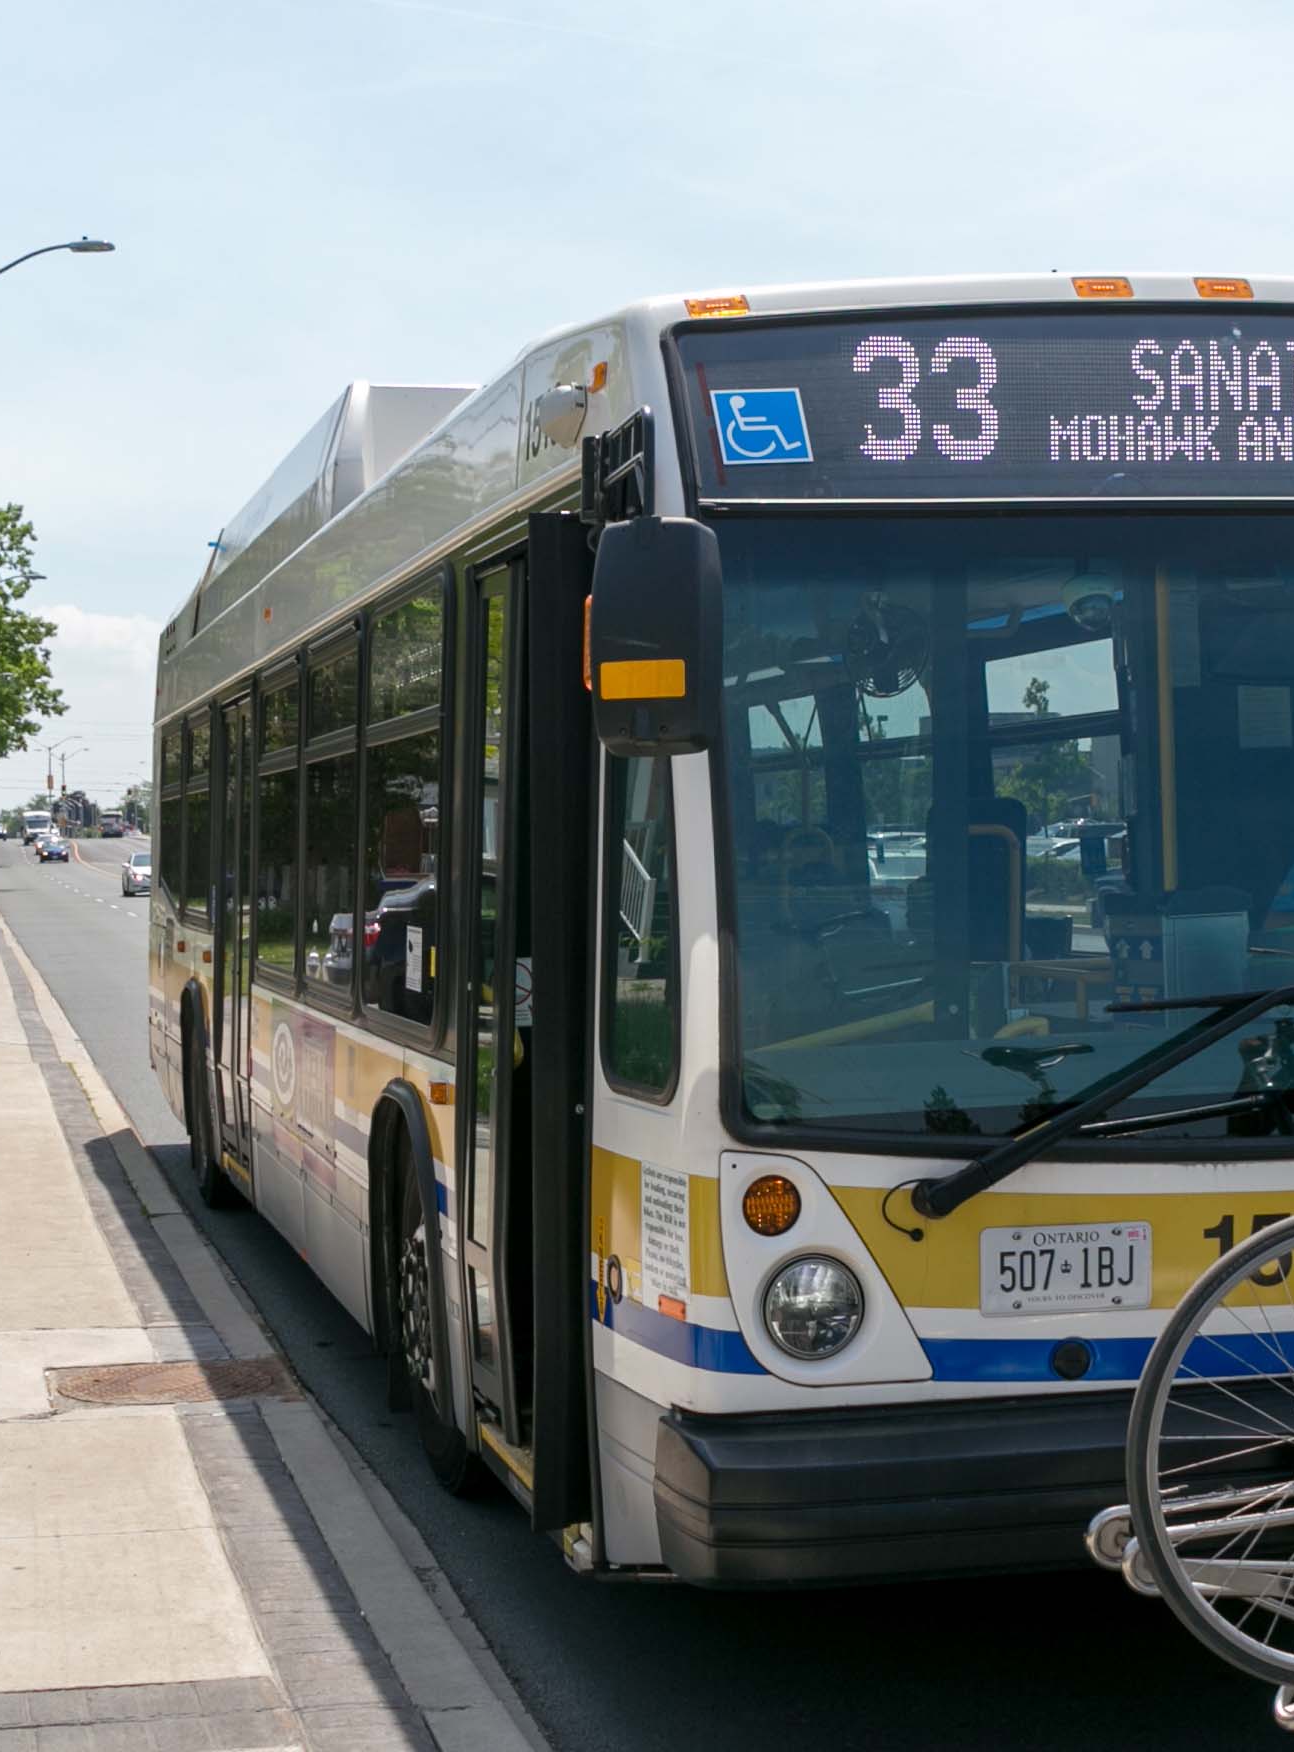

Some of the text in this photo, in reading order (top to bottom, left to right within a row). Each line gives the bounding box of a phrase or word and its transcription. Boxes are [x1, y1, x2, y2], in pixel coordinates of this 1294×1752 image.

[852, 335, 999, 461] 33
[1050, 415, 1220, 461] MOHAWK
[999, 1245, 1134, 1292] 507 1BJ
